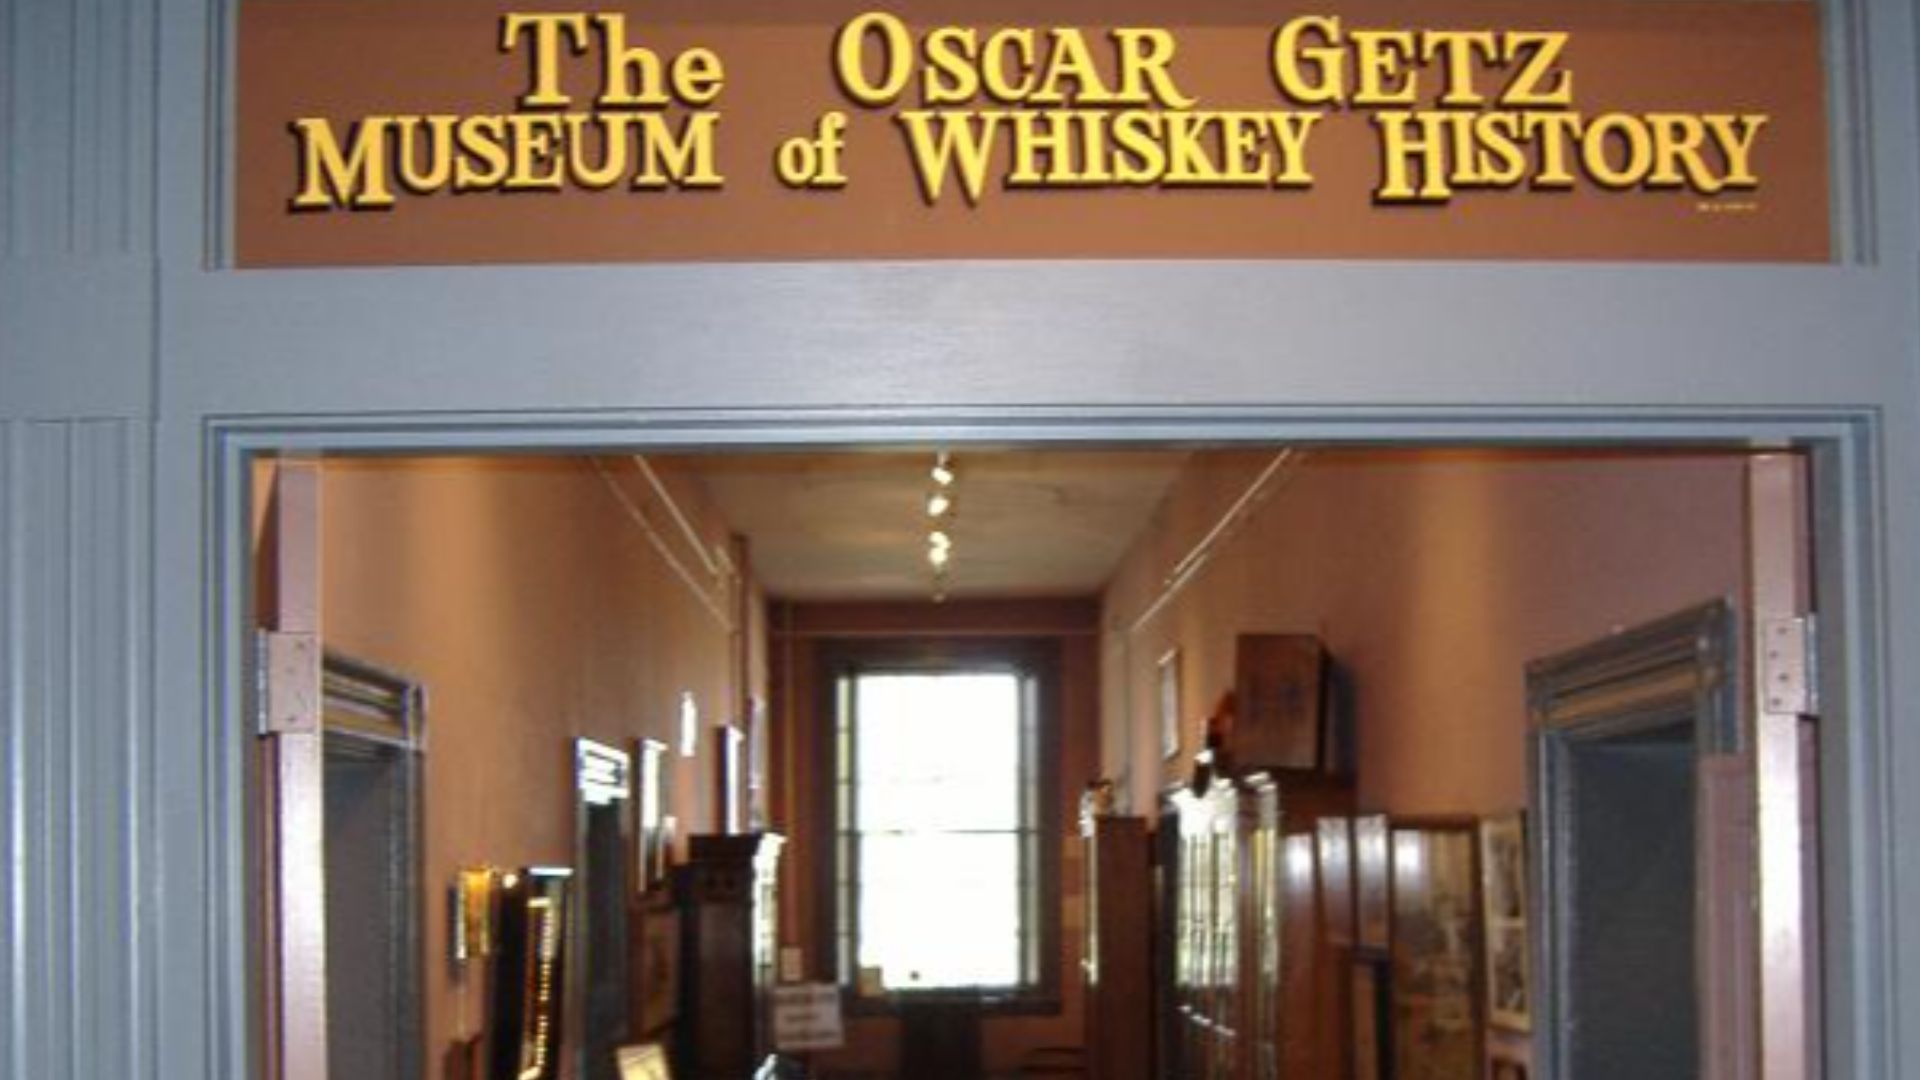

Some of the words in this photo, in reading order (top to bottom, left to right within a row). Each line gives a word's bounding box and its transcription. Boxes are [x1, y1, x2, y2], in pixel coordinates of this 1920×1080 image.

[504, 12, 724, 105] The
[837, 11, 1199, 109] OSCAR
[1274, 15, 1572, 105] GETZ
[295, 111, 724, 205] MUSEUM
[778, 111, 848, 185] of
[900, 109, 1324, 202] WHISKEY
[1375, 111, 1768, 200] HISTORY
